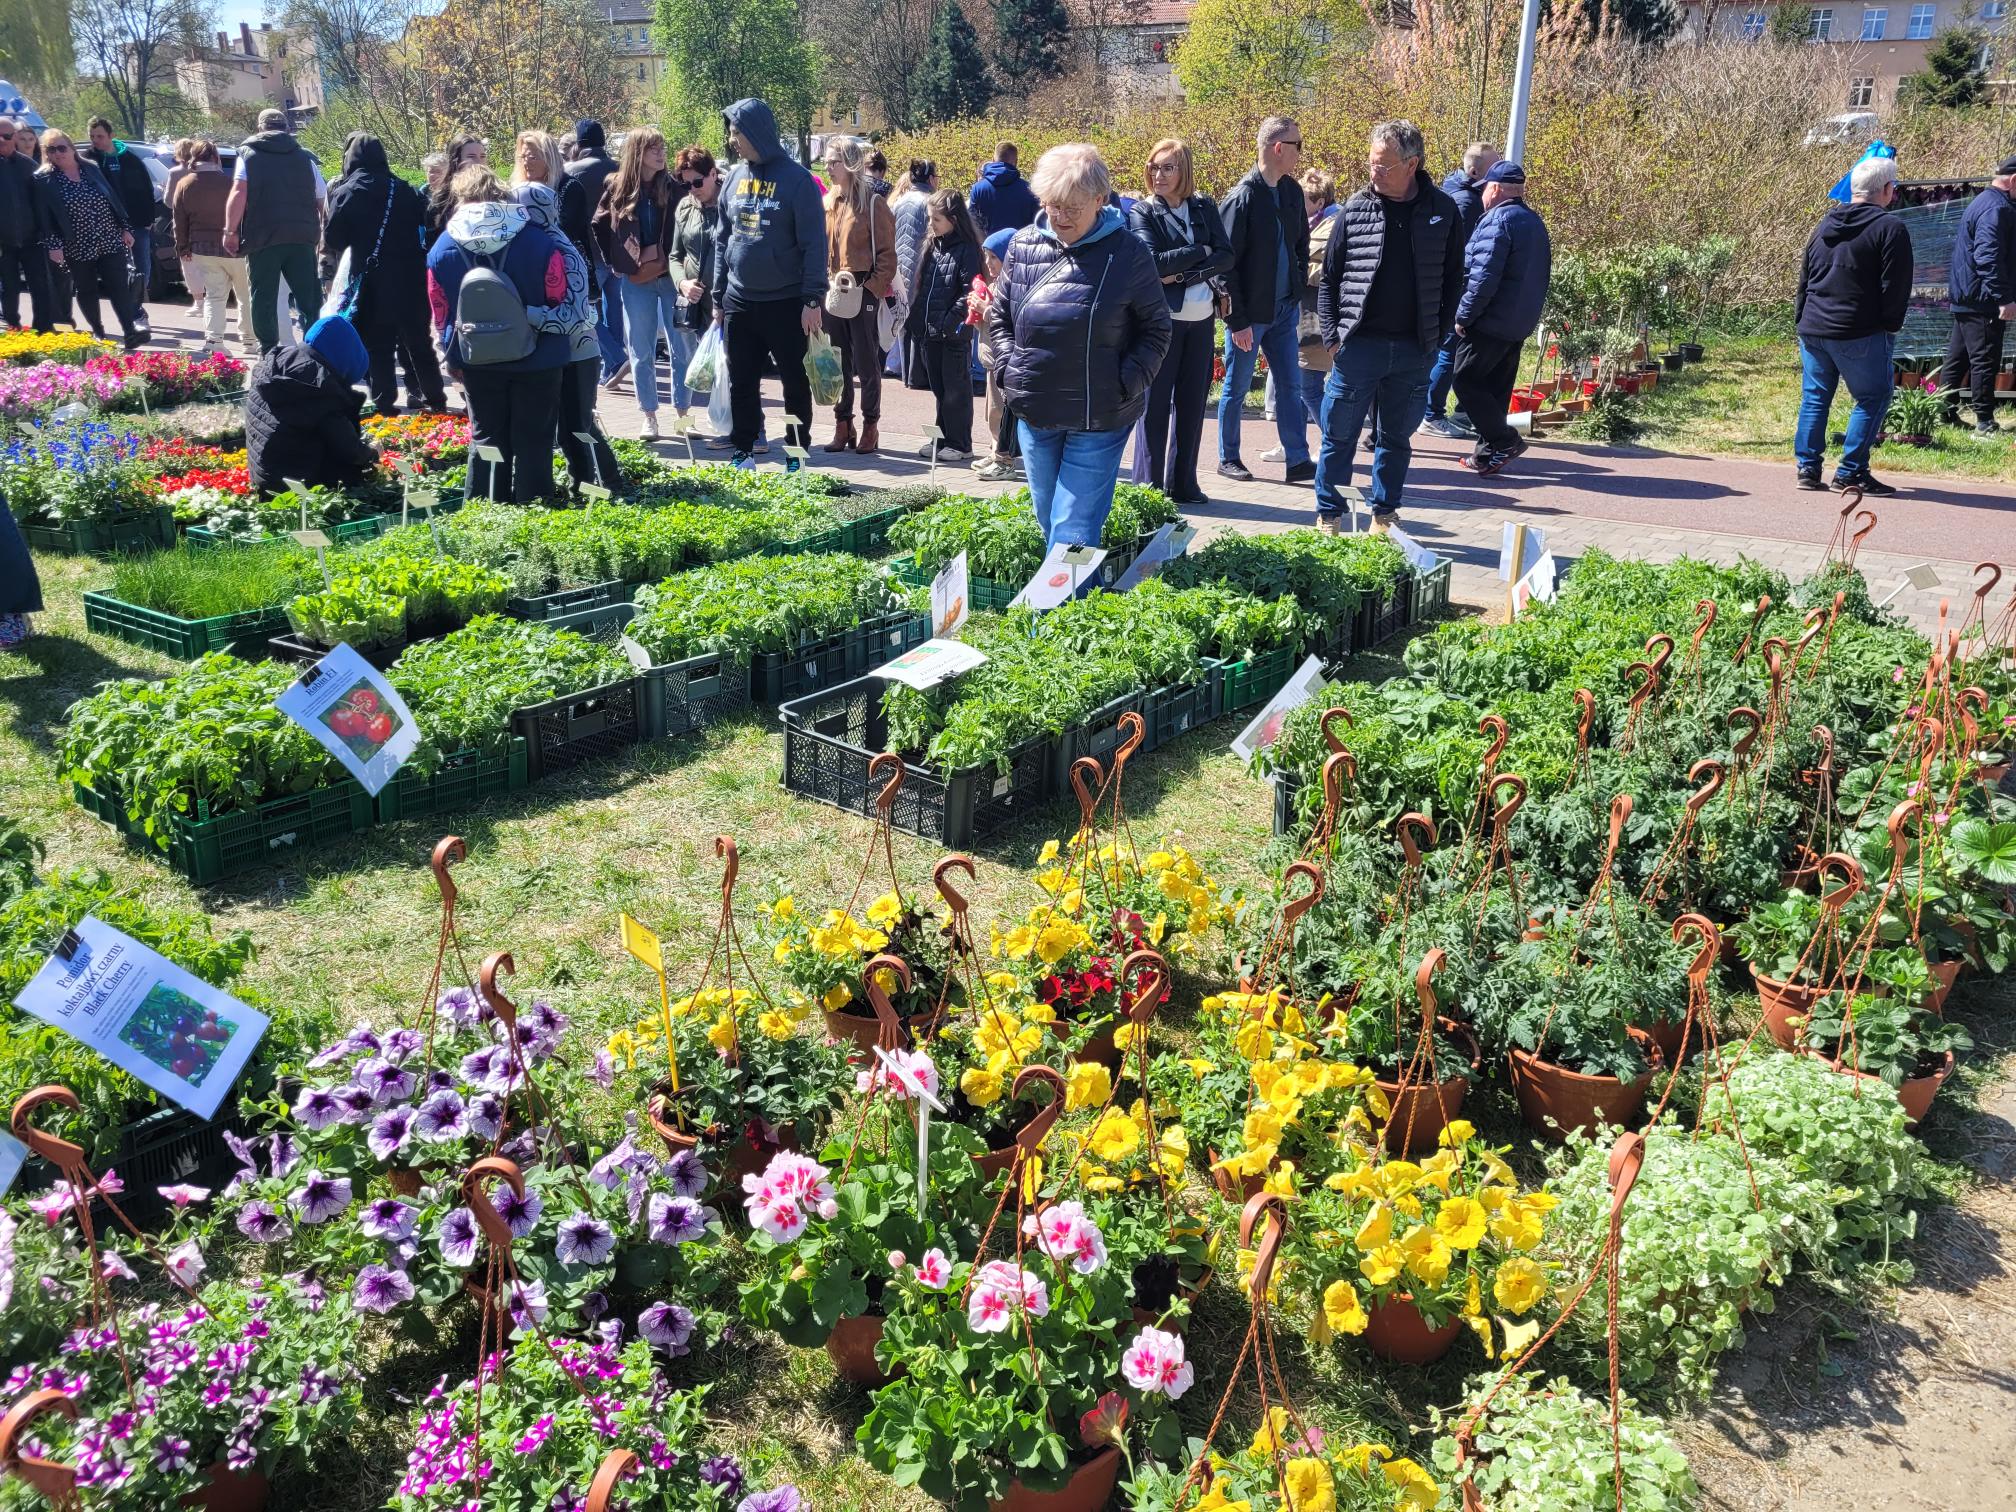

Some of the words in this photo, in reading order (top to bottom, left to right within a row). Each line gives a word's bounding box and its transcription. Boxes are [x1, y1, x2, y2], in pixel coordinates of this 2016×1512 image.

[305, 678, 329, 696] Robin
[56, 953, 91, 988] Pomidor
[57, 970, 102, 1017] koktajlowy
[97, 943, 124, 970] czarny
[83, 989, 109, 1016] Black
[103, 960, 133, 990] Cherry
